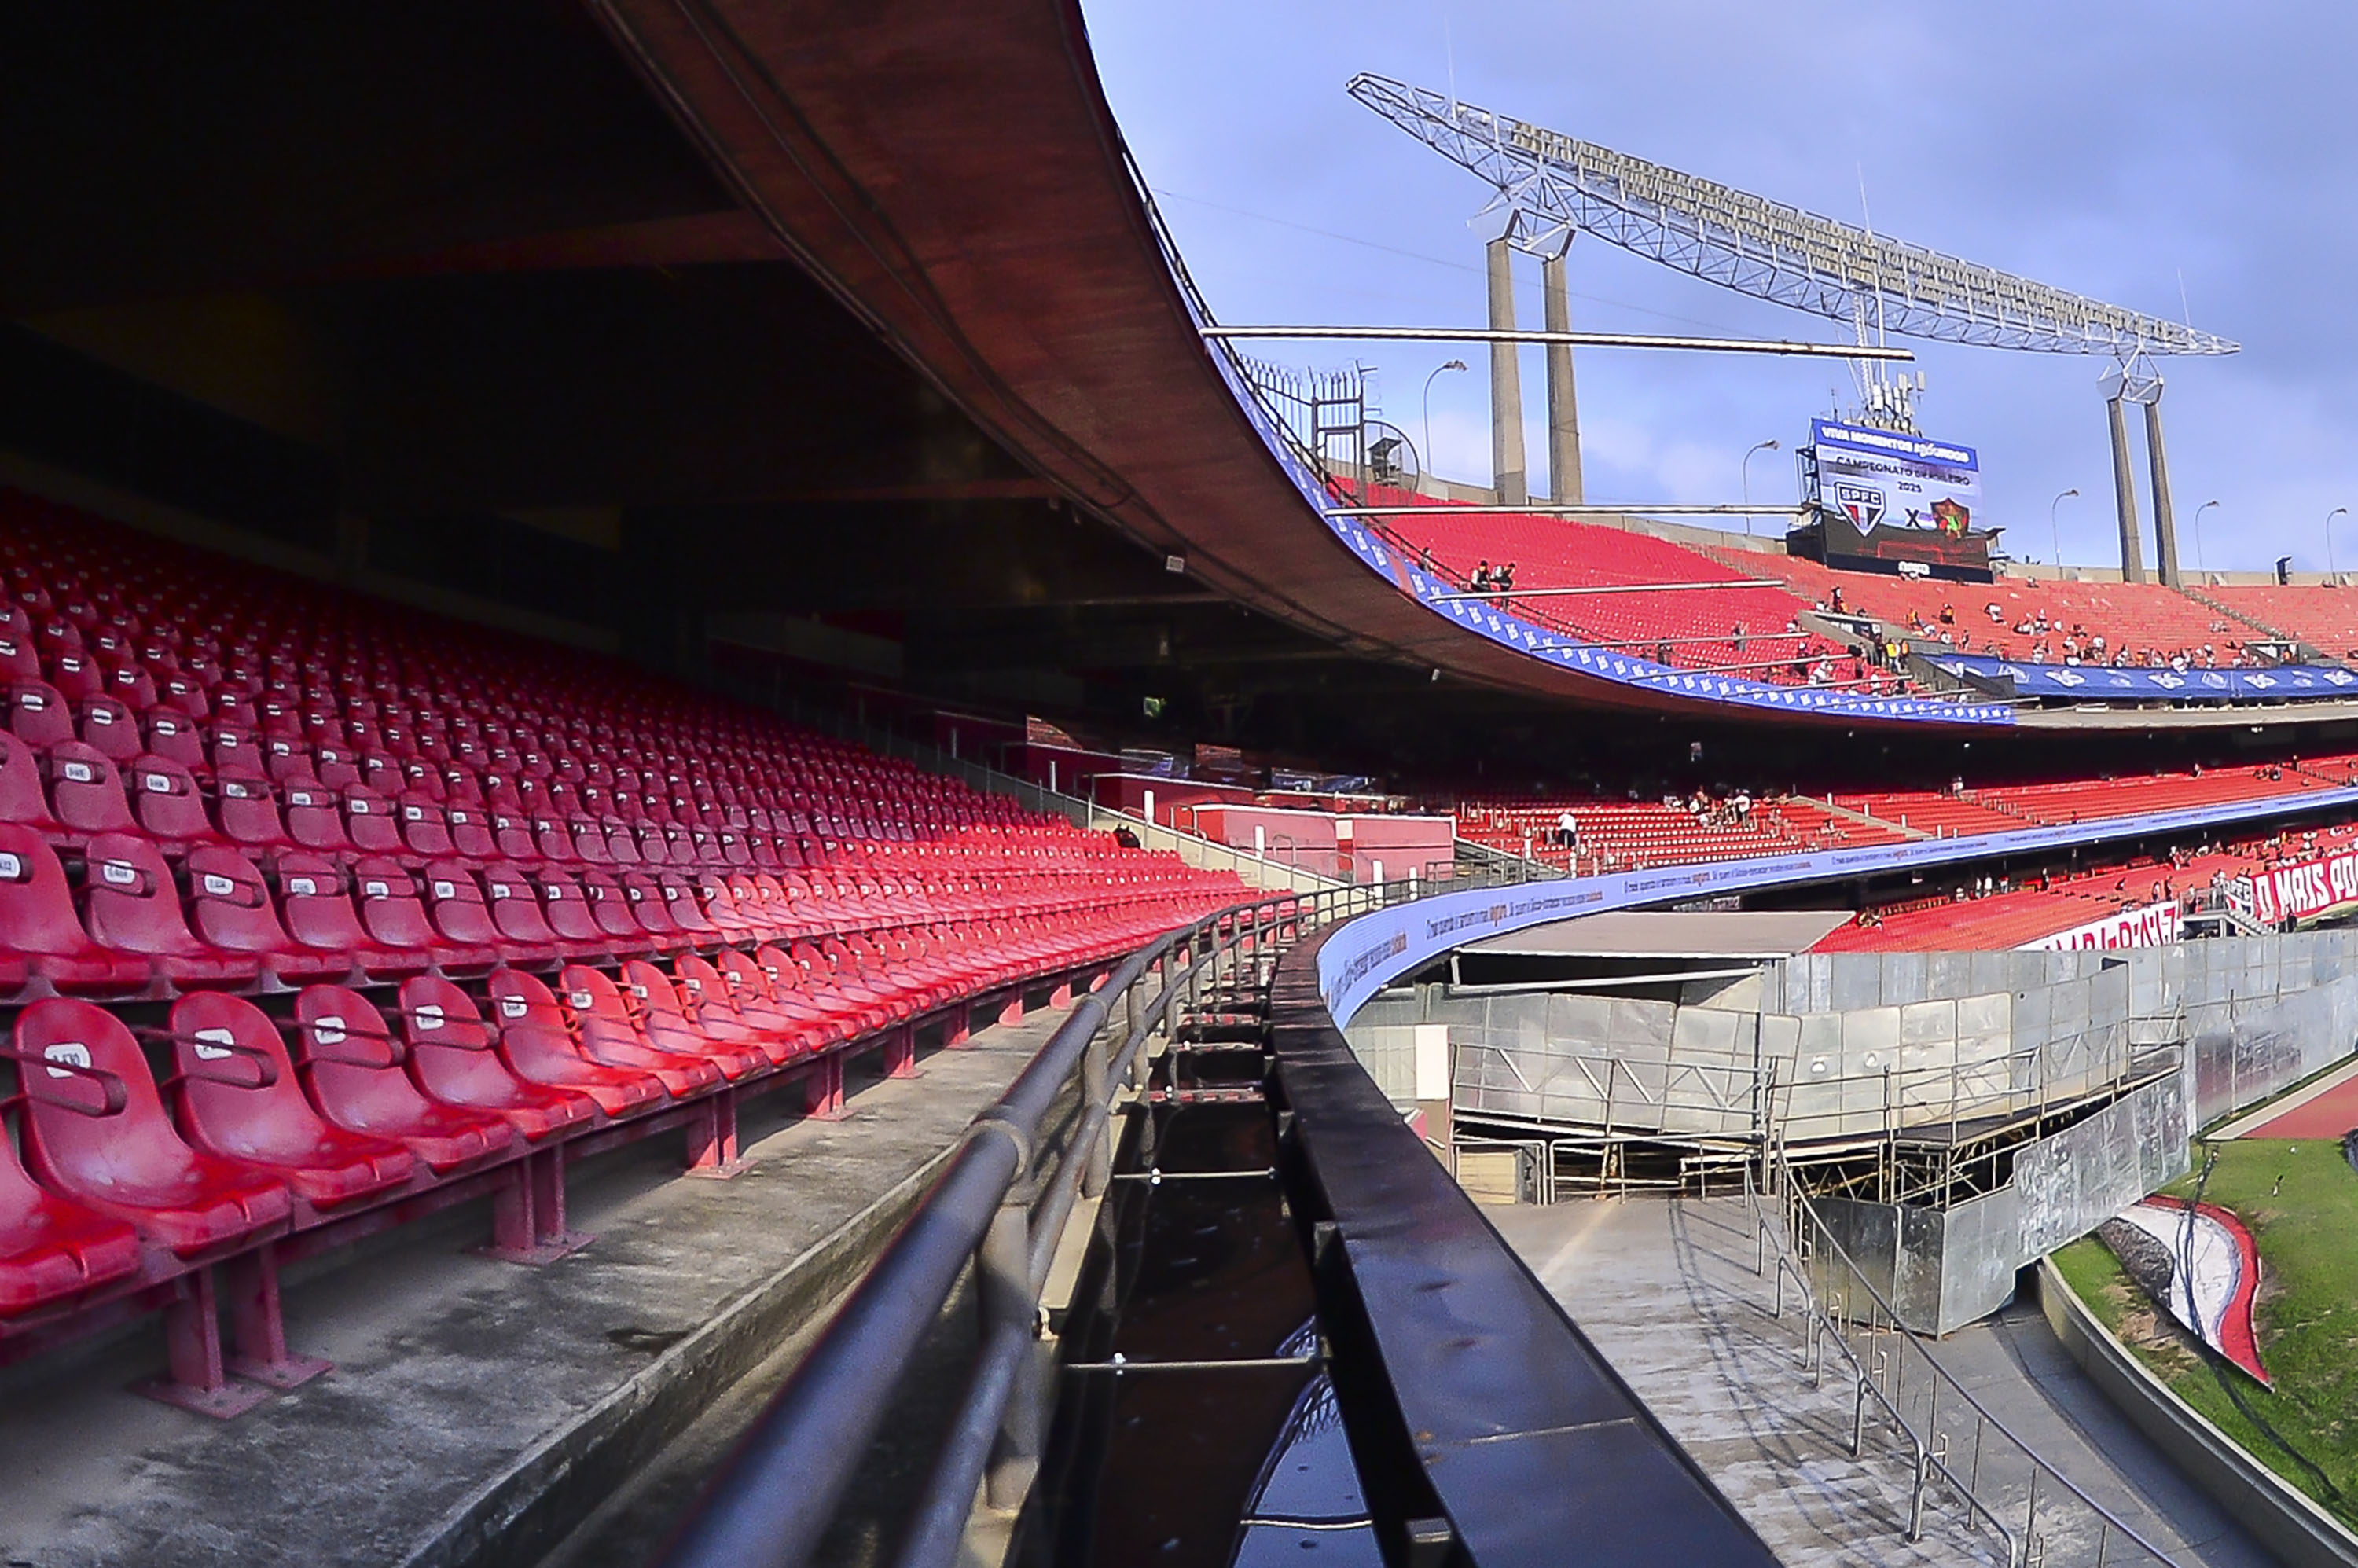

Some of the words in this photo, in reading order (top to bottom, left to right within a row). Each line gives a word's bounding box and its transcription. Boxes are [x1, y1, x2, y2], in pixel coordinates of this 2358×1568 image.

[1821, 425, 1850, 442] VIVA
[1835, 456, 1913, 477] CAMPEONATO
[1840, 489, 1881, 505] SPFC
[2274, 862, 2331, 917] MAIS
[2330, 854, 2358, 902] PO
